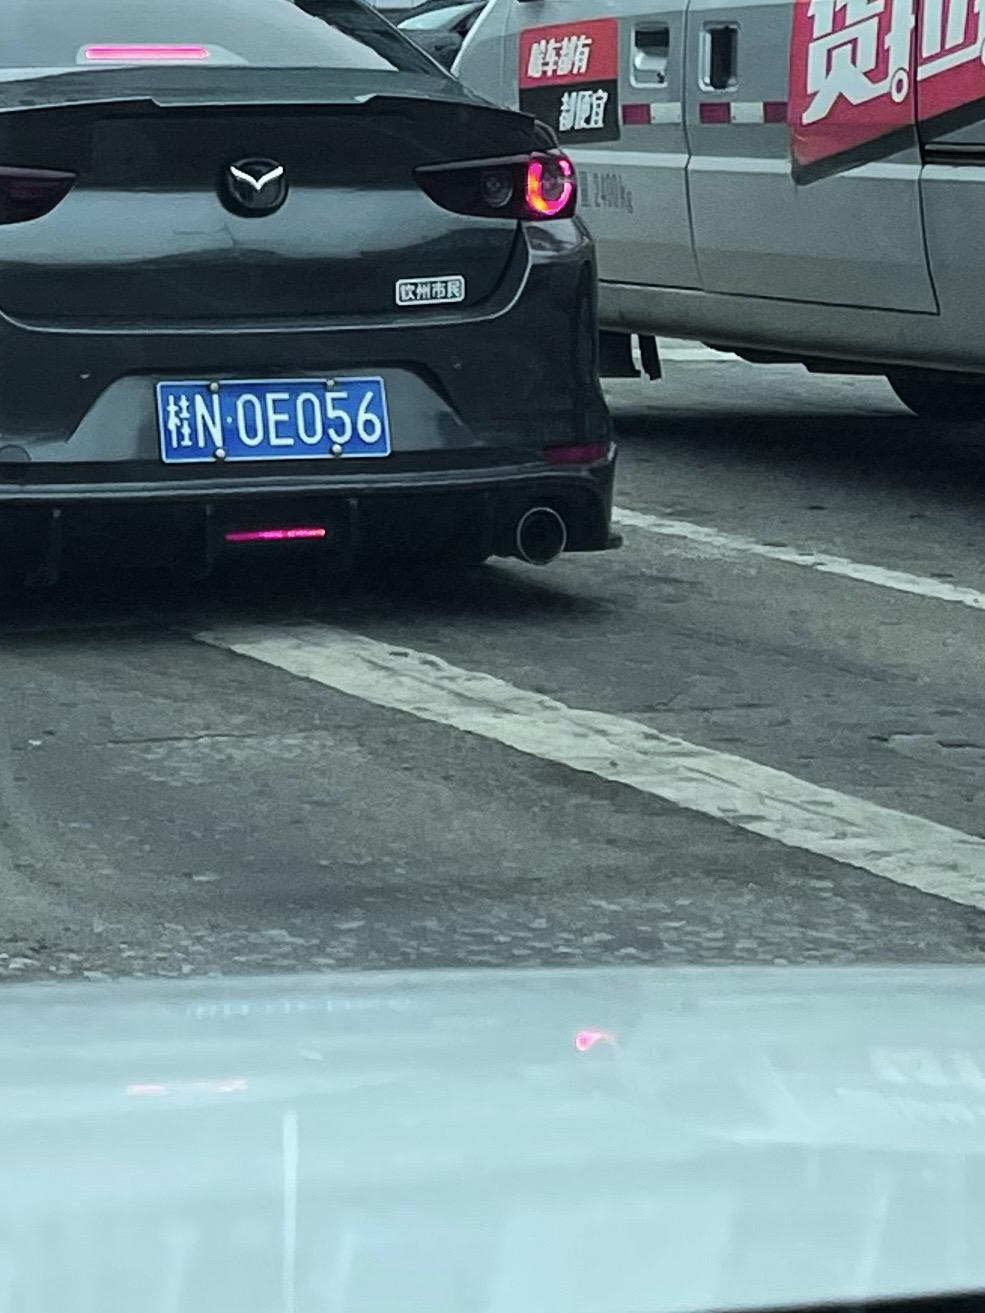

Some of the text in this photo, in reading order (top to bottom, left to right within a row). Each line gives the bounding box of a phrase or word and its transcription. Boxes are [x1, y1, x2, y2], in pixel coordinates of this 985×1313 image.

[399, 280, 461, 301] 钦州市民
[167, 391, 383, 449] 桂N·0E056
